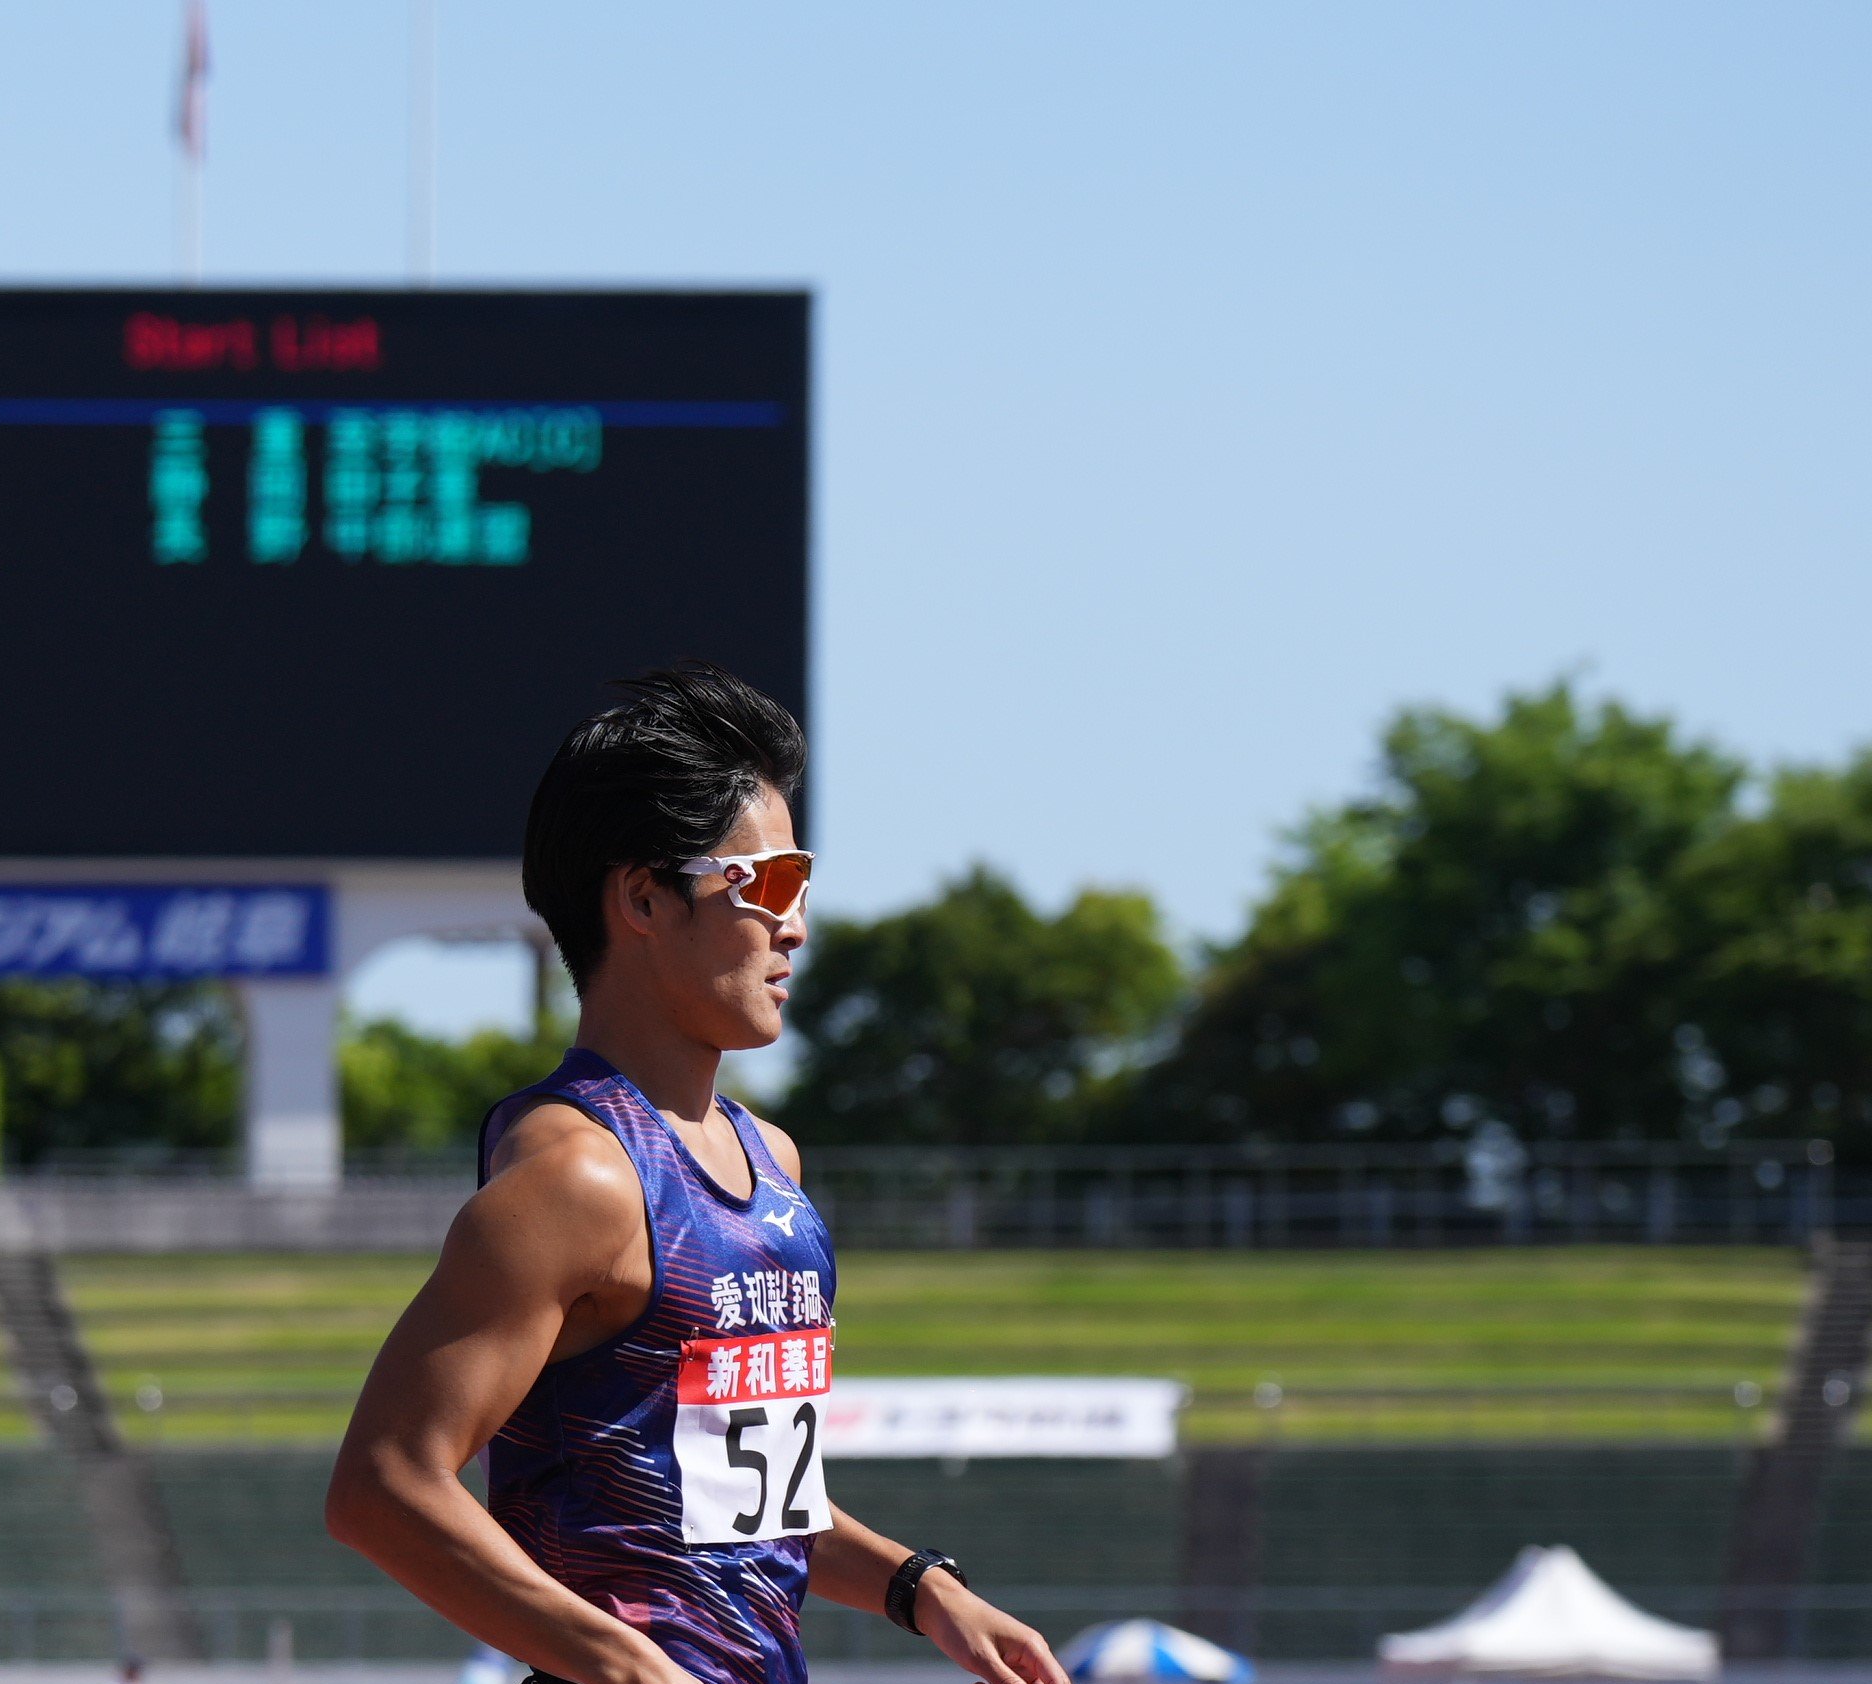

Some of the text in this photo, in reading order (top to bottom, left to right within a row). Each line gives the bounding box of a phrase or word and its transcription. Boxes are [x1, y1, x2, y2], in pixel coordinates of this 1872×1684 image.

[710, 1270, 822, 1330] 愛知製鋼
[706, 1337, 827, 1400] 新和薬品
[725, 1401, 817, 1536] 52
